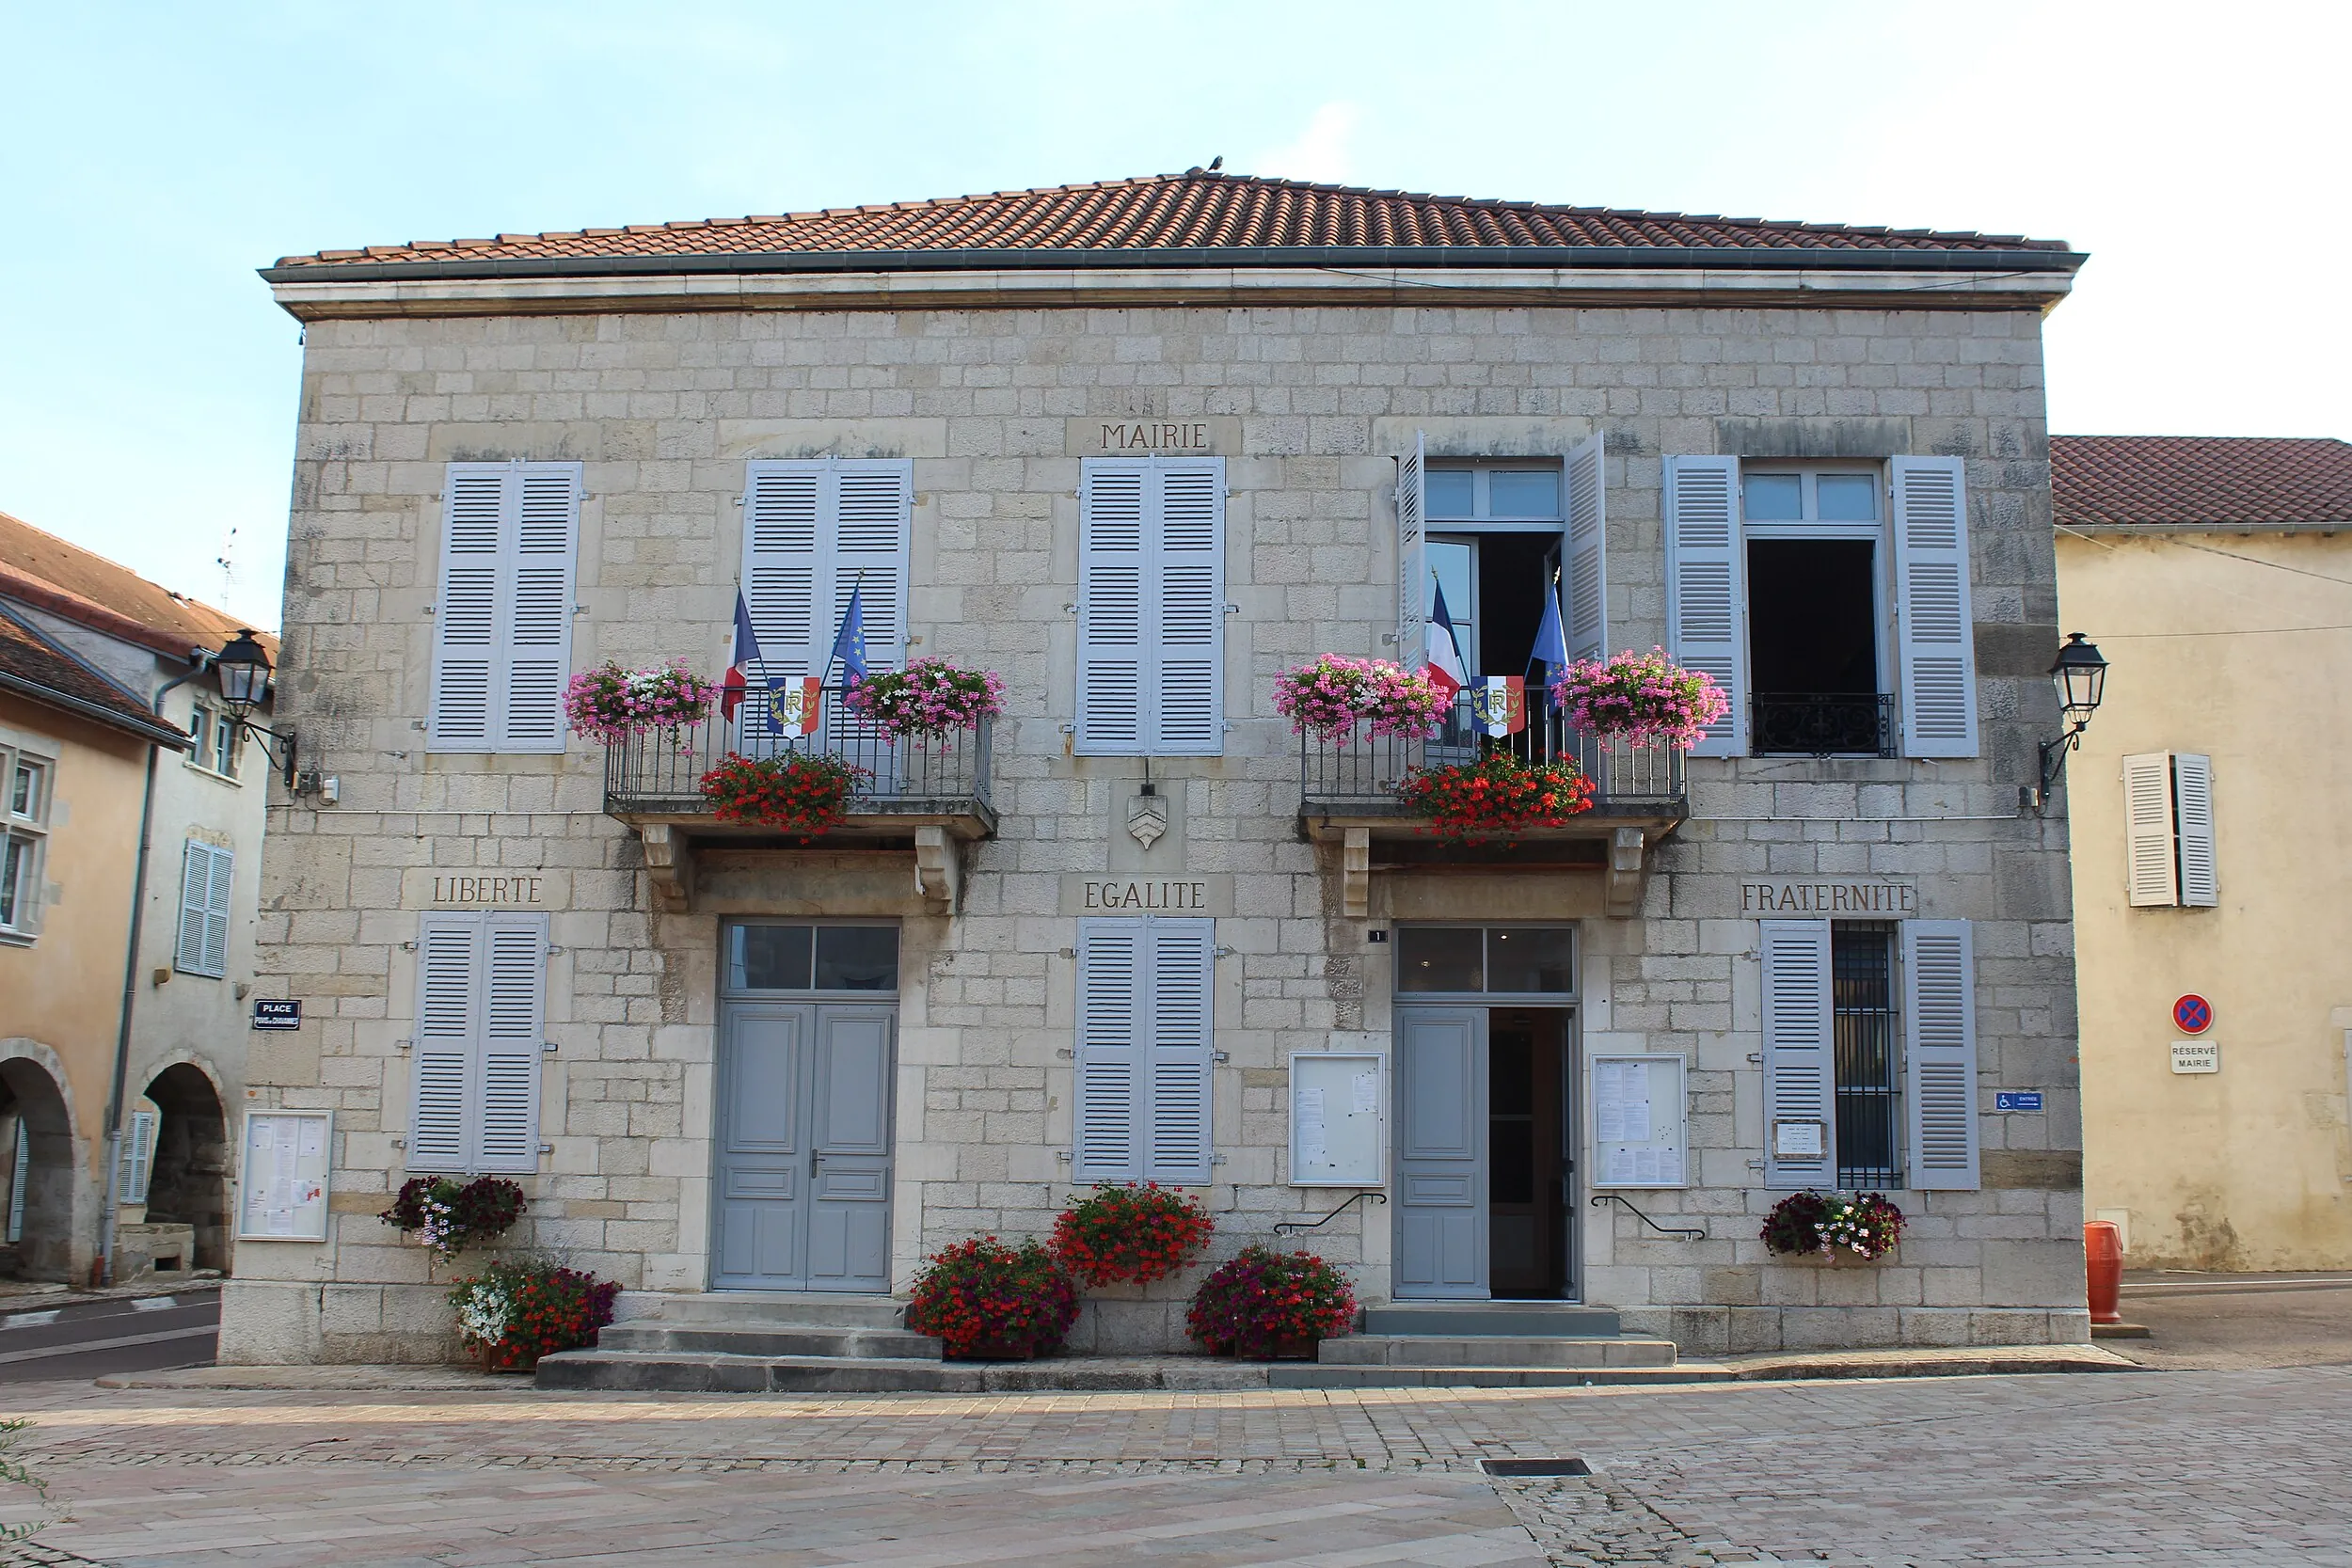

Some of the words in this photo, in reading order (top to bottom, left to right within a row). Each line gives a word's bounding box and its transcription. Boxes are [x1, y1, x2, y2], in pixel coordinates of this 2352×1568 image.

[1101, 423, 1207, 449] MAIRIE
[433, 877, 543, 903] LIBERTE
[1084, 882, 1205, 909] EGALITE
[1741, 884, 1914, 911] FRATERNITE
[1375, 931, 1380, 941] 1
[262, 1005, 293, 1013] PLACE
[2172, 1046, 2217, 1055] RÉSERVÉ
[2178, 1059, 2212, 1068] MAIRIE
